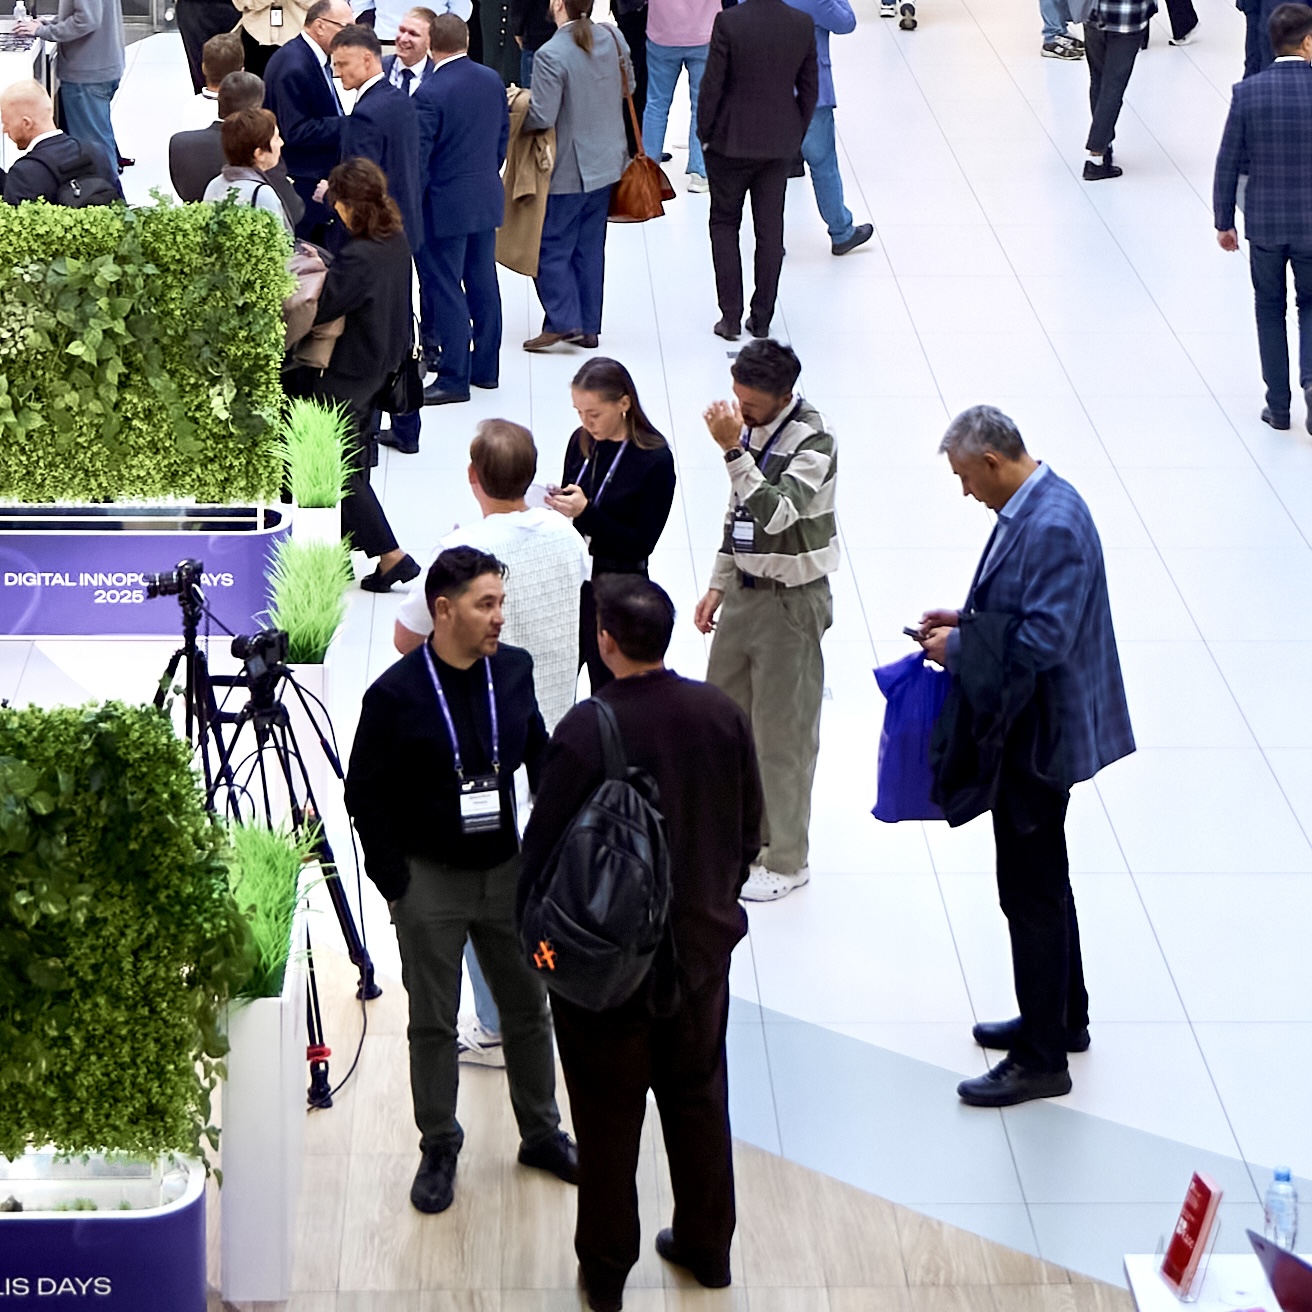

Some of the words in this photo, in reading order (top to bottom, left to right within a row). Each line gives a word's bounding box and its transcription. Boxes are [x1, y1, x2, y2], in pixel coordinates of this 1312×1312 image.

[4, 572, 77, 586] DIGITAL
[199, 573, 234, 587] AYS
[94, 589, 145, 604] 2025
[36, 1276, 113, 1297] DAYS
